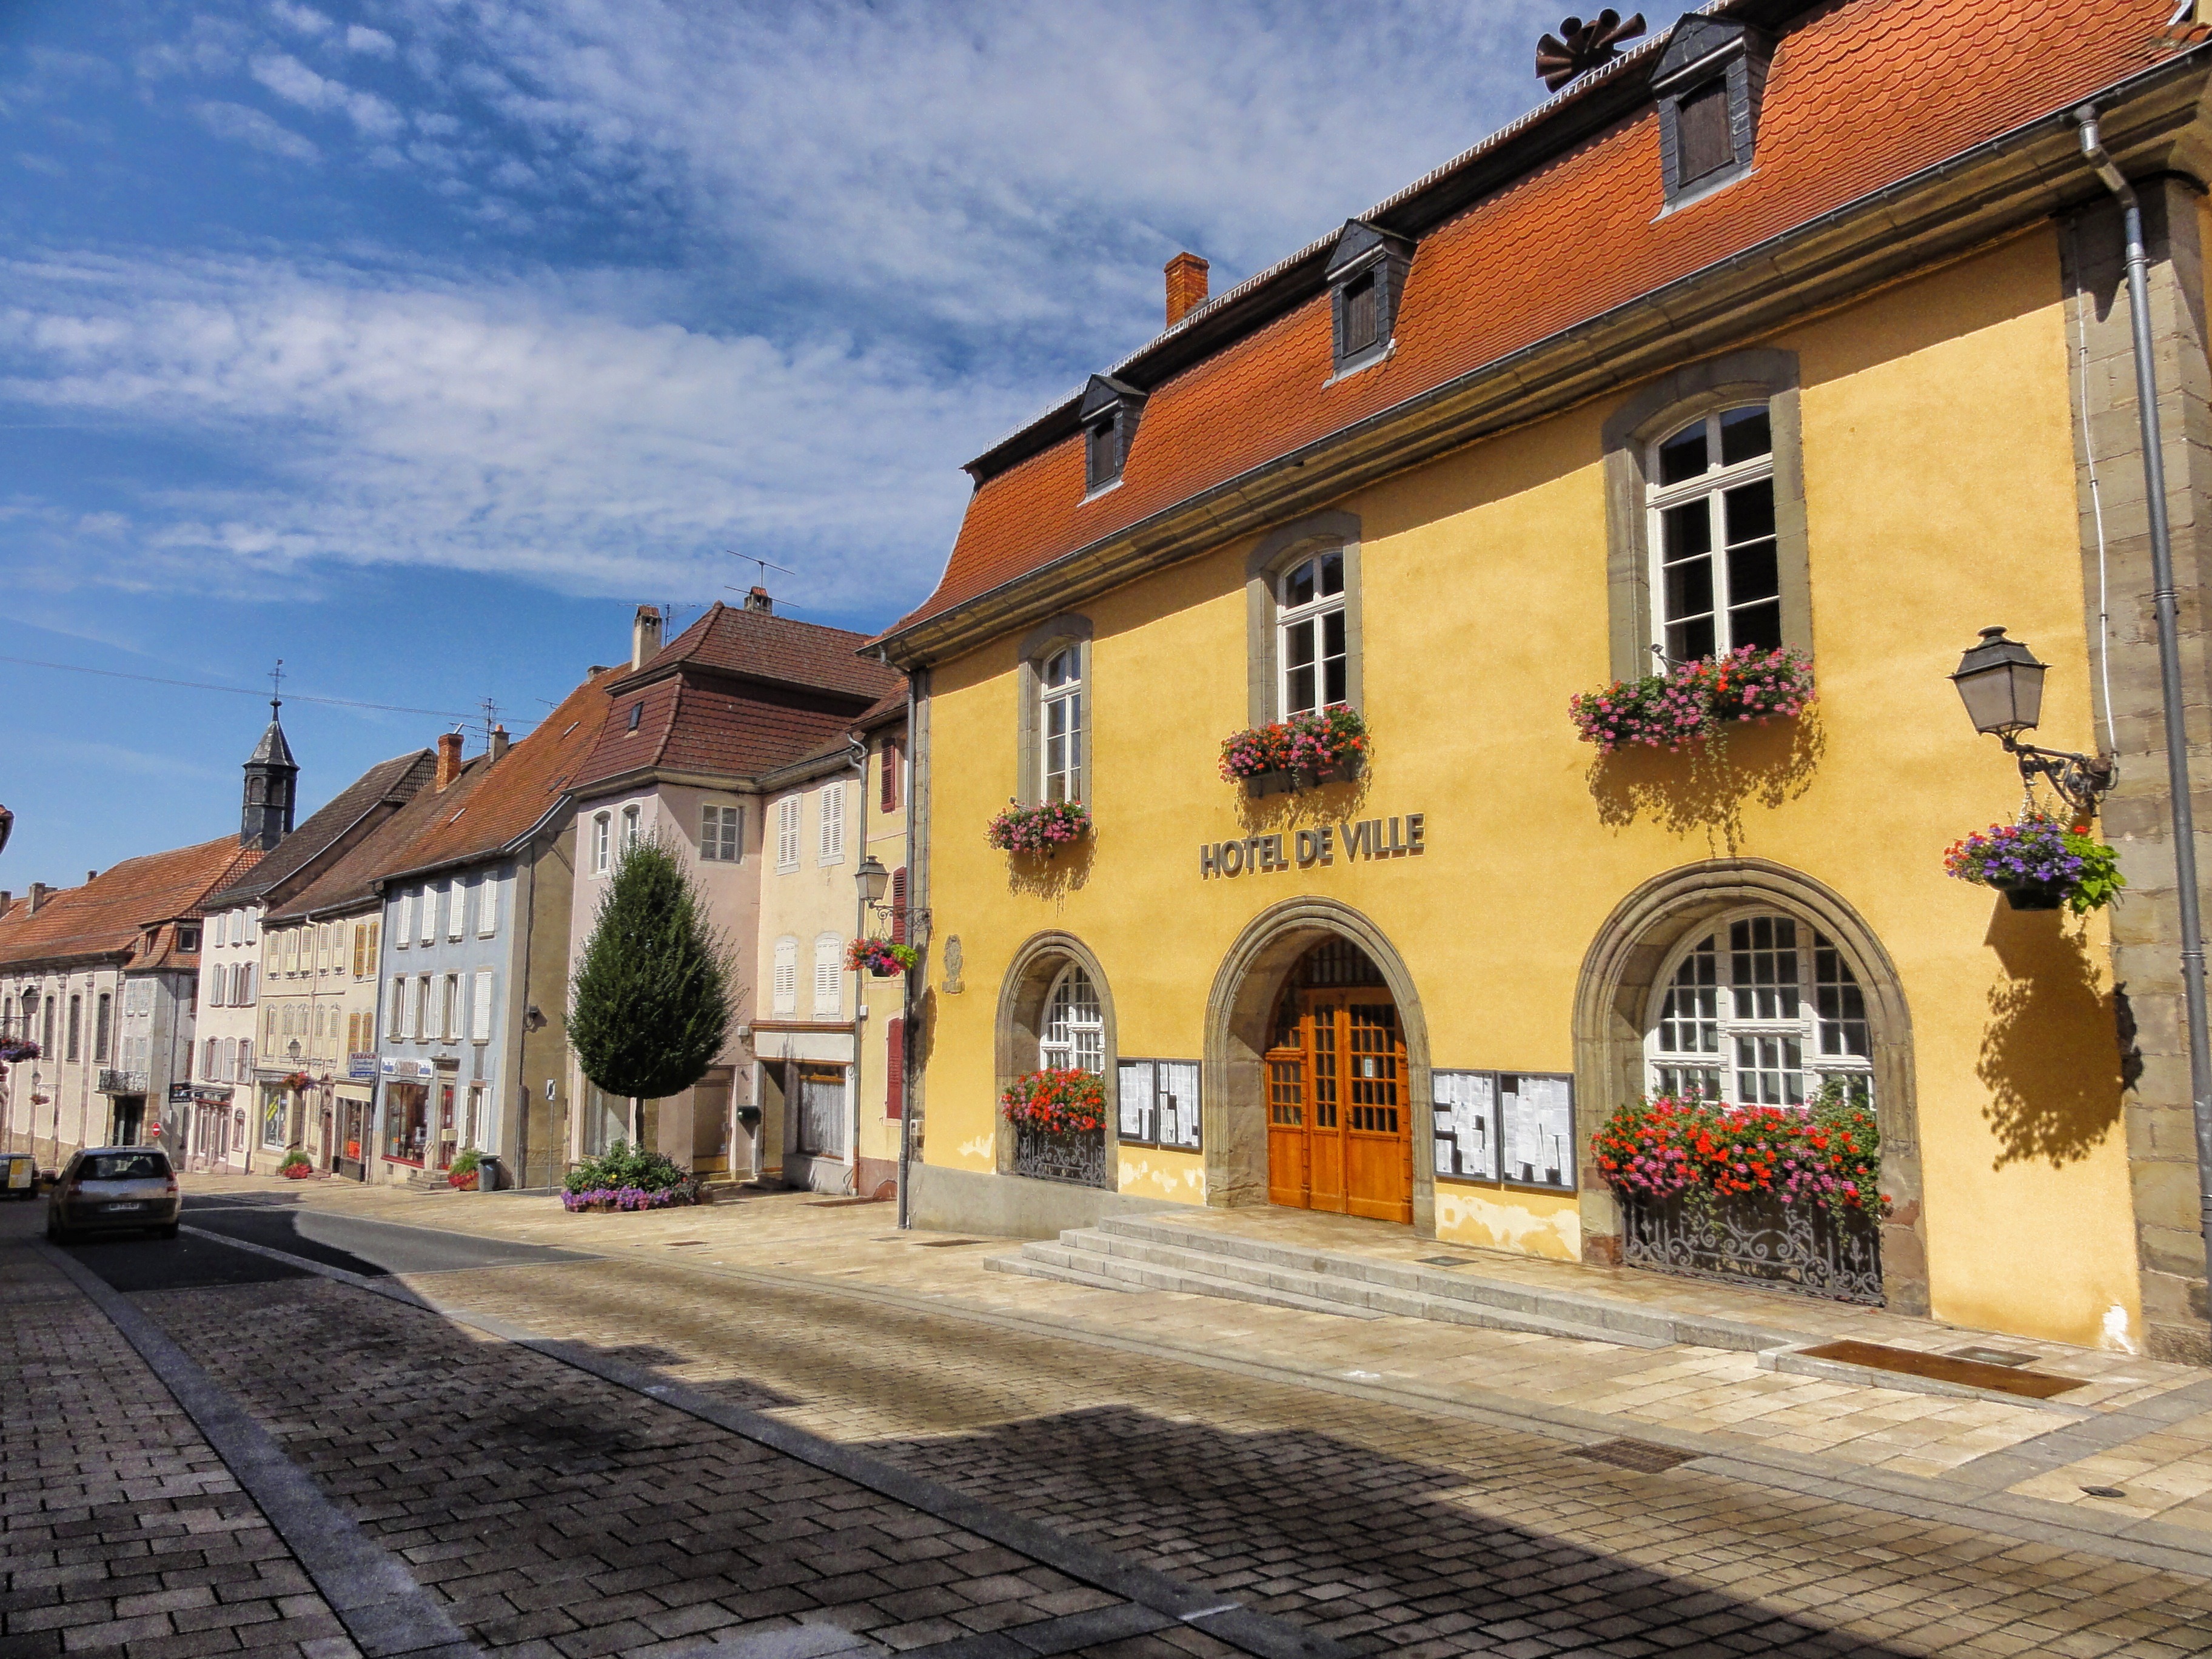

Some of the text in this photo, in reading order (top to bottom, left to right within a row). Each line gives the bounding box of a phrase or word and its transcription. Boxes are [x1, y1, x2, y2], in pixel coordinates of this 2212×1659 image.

[1200, 813, 1425, 879] HOTEL DE VILLE
